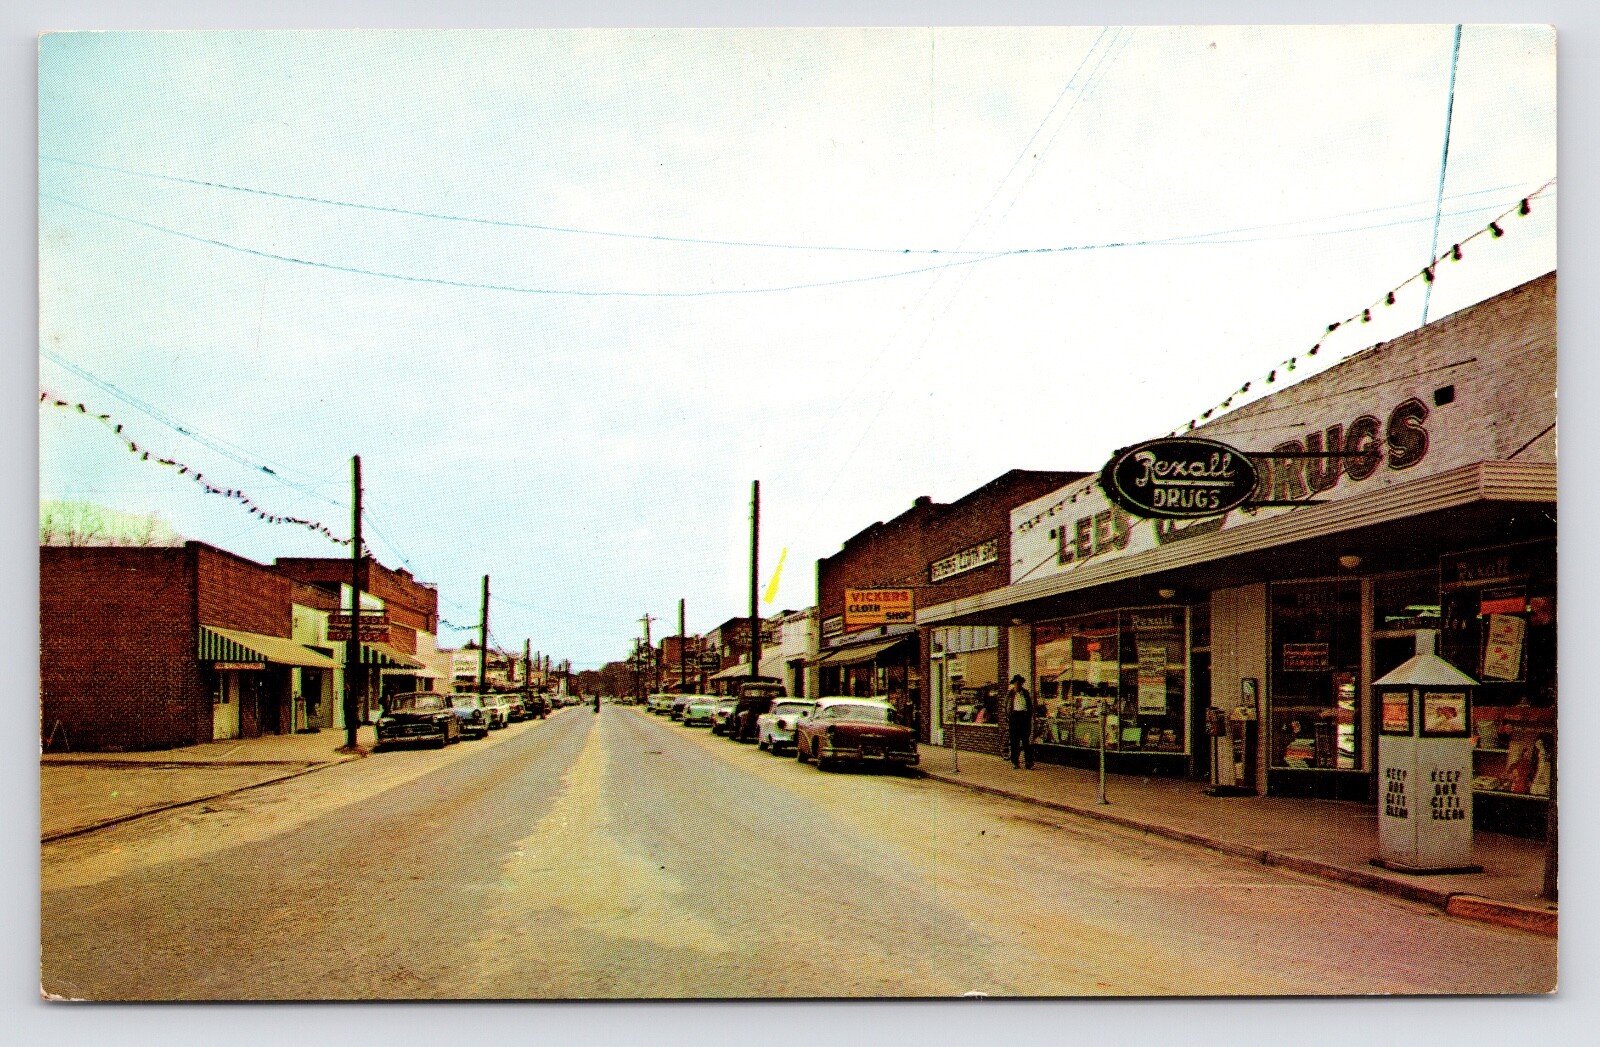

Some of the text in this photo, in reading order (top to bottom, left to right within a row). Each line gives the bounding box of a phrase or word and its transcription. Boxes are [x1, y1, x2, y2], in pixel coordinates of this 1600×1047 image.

[1134, 450, 1235, 488] Rexall
[1152, 487, 1220, 509] DRUGS
[850, 590, 909, 603] VICKERS
[847, 603, 881, 613] CLOTH
[884, 610, 912, 620] SHOP
[1130, 613, 1174, 630] Rexall
[1386, 767, 1408, 781] KEEP
[1431, 770, 1461, 783] KEEP
[1386, 804, 1409, 819] CLEAN
[1432, 808, 1465, 821] CLEAN
